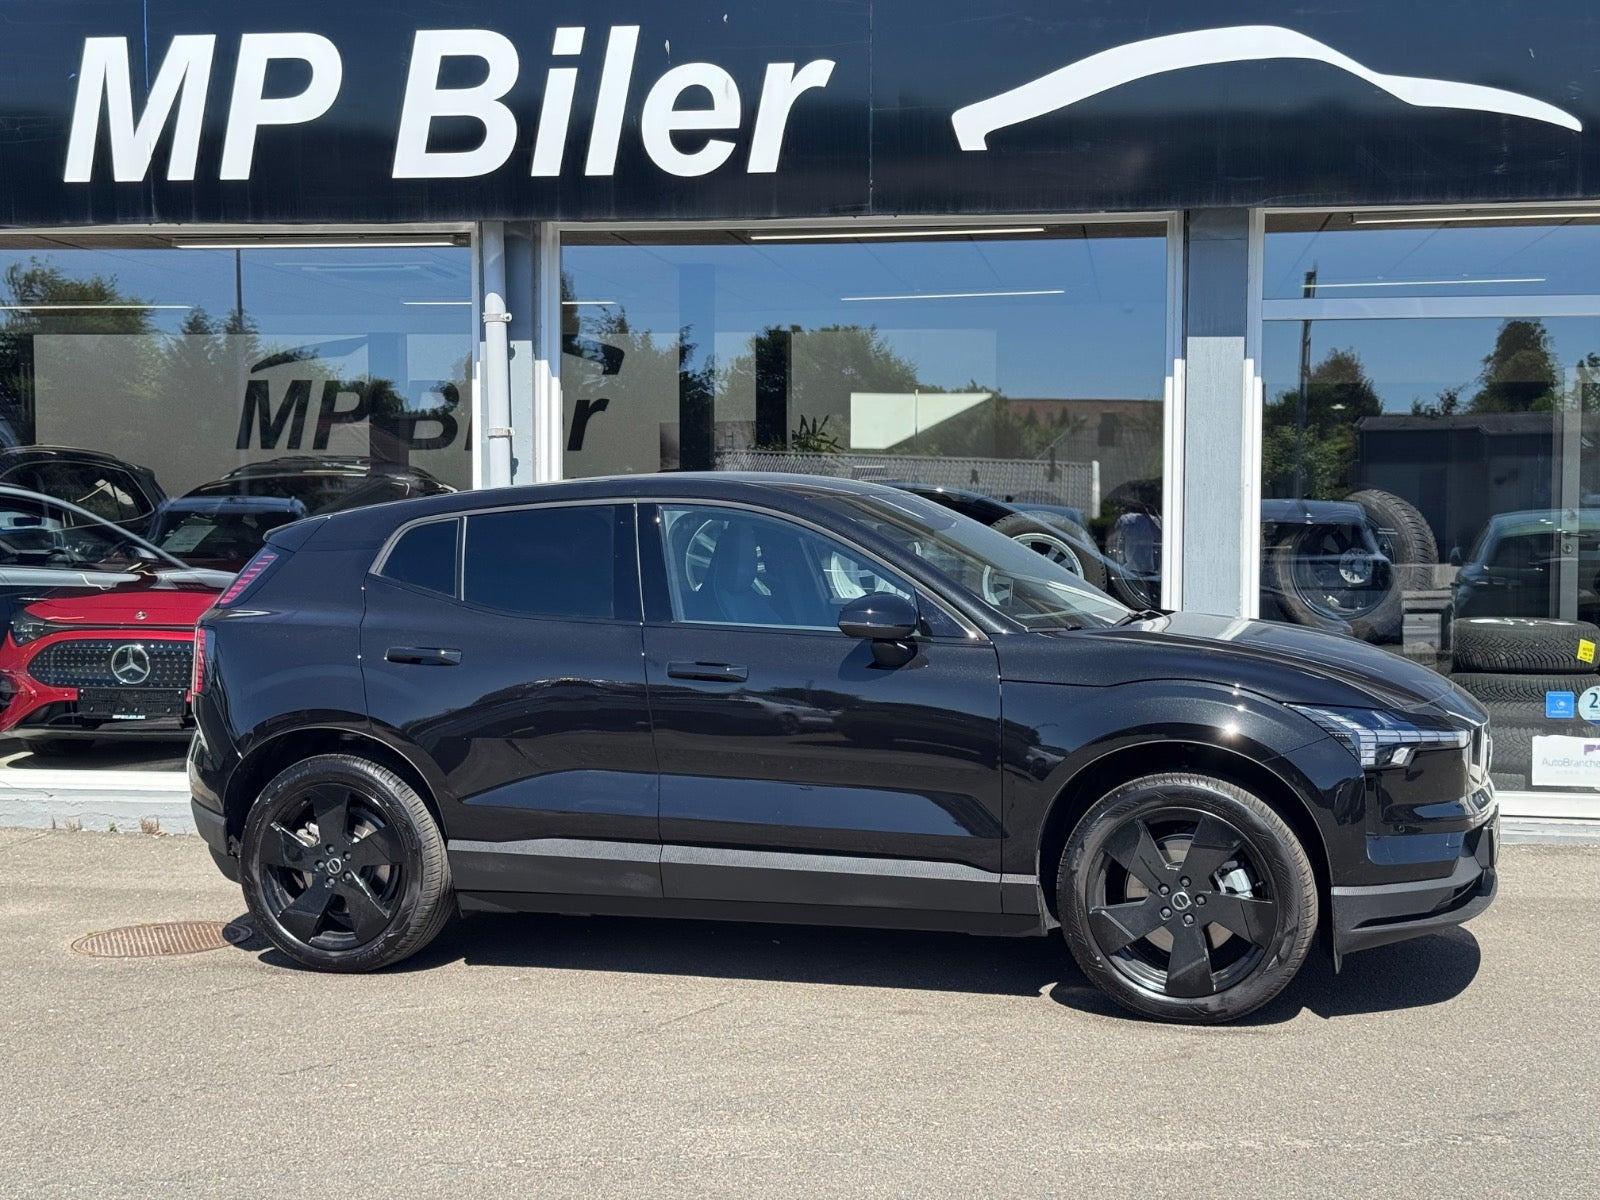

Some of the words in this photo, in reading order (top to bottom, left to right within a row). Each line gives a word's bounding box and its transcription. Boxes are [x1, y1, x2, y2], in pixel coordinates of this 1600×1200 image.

[64, 32, 343, 183] MP
[392, 25, 836, 179] Biler
[235, 380, 370, 450] MP
[1589, 692, 1600, 708] 2
